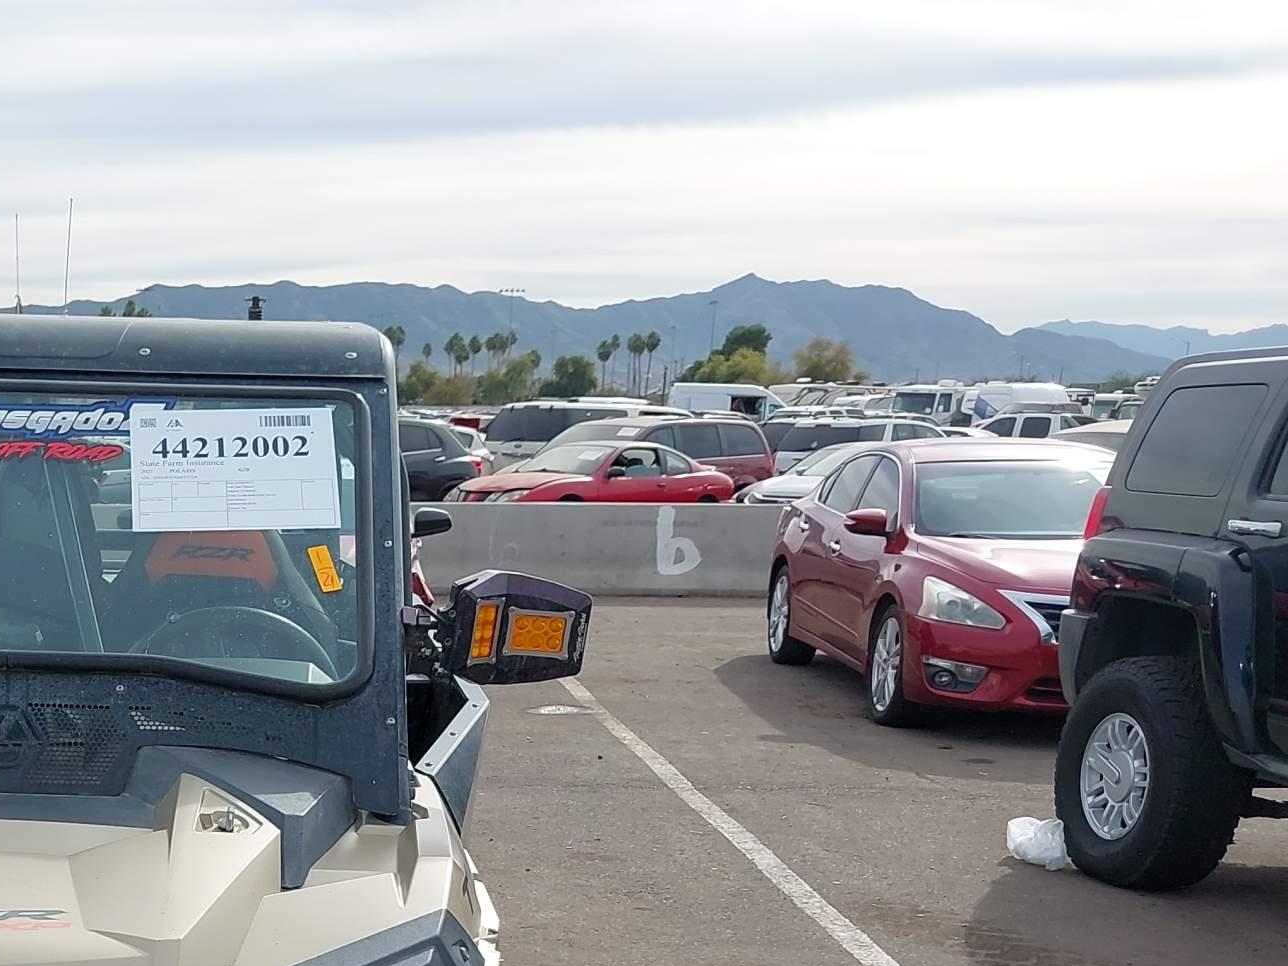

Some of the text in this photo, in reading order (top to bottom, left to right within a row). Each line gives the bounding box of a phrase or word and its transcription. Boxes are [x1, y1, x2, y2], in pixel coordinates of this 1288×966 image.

[43, 442, 124, 461] ROAD
[152, 434, 310, 459] 44212002
[186, 459, 225, 467] Insurance
[173, 546, 256, 562] RZR
